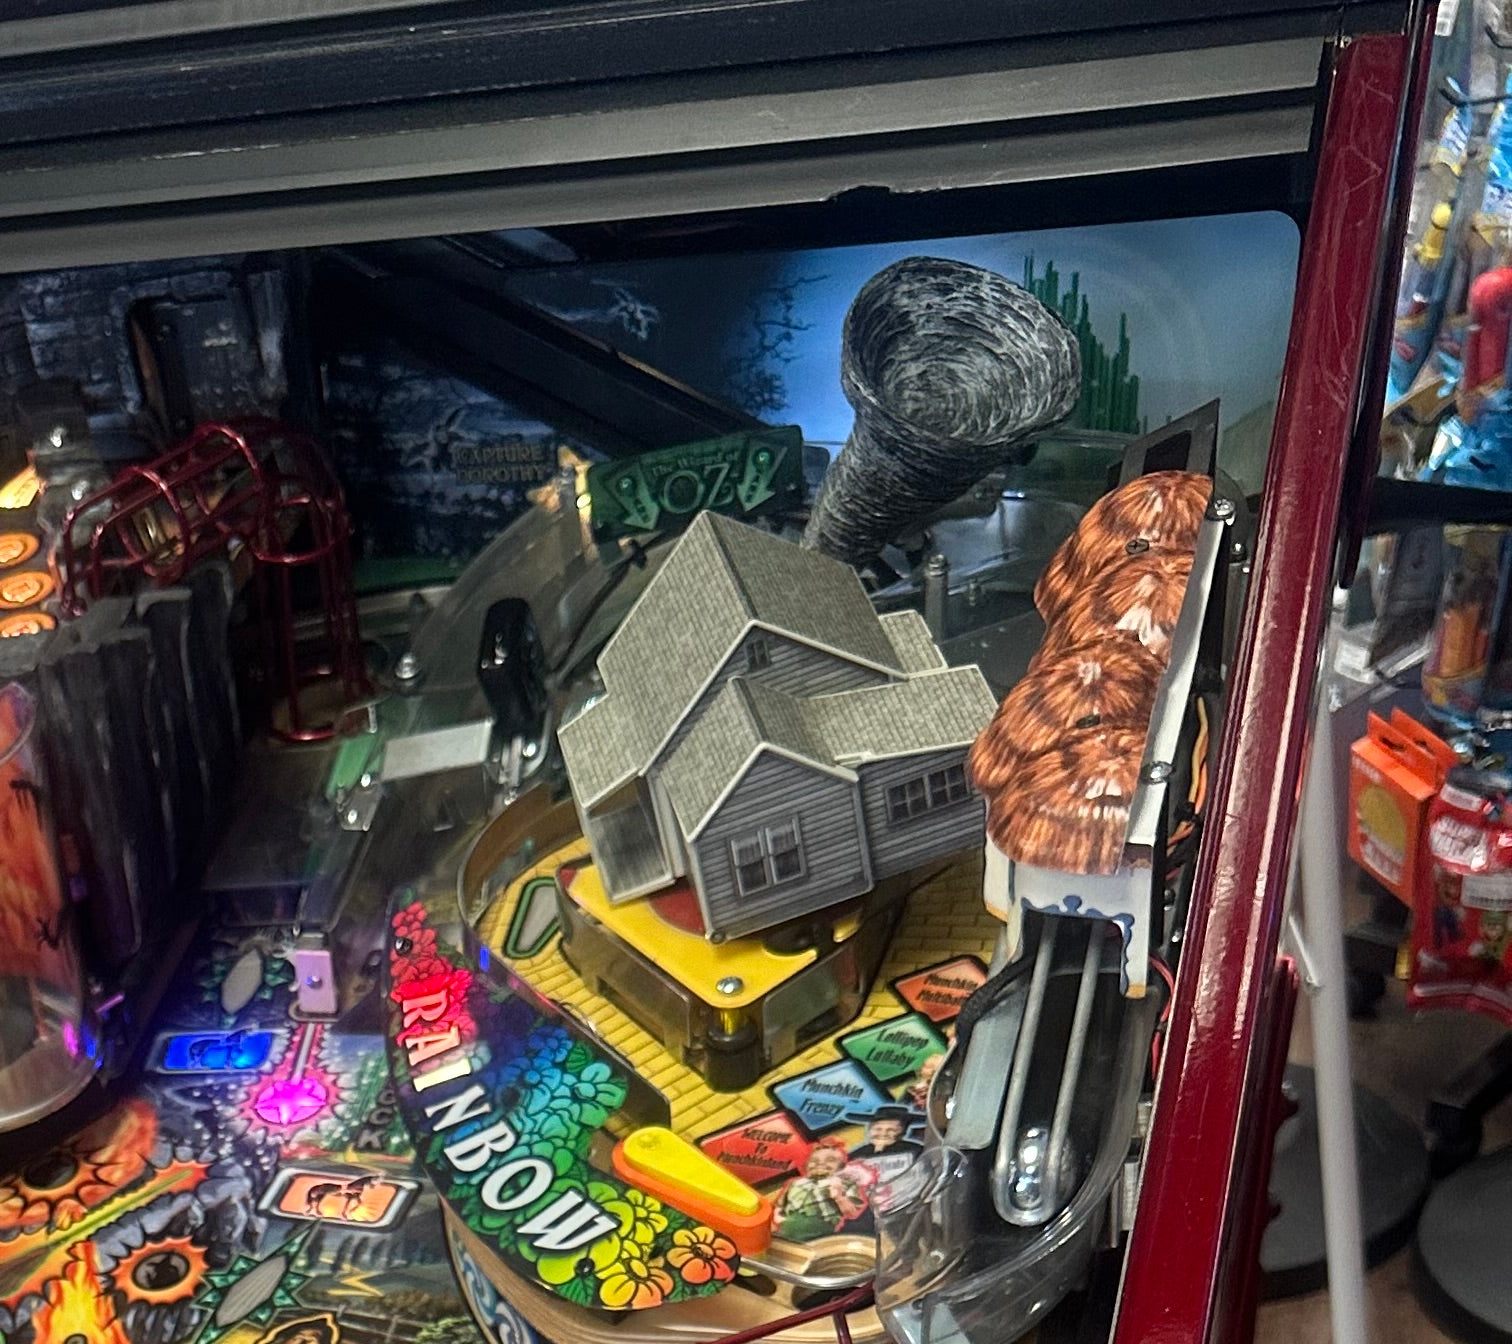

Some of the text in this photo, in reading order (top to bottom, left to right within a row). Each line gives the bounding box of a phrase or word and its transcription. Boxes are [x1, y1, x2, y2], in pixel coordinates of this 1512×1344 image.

[877, 1028, 930, 1051] Lollipop
[866, 1047, 916, 1070] Lullaby
[800, 1077, 865, 1102] Munchkin
[401, 989, 622, 1251] RAINBOW
[798, 1097, 846, 1120] Frenzy
